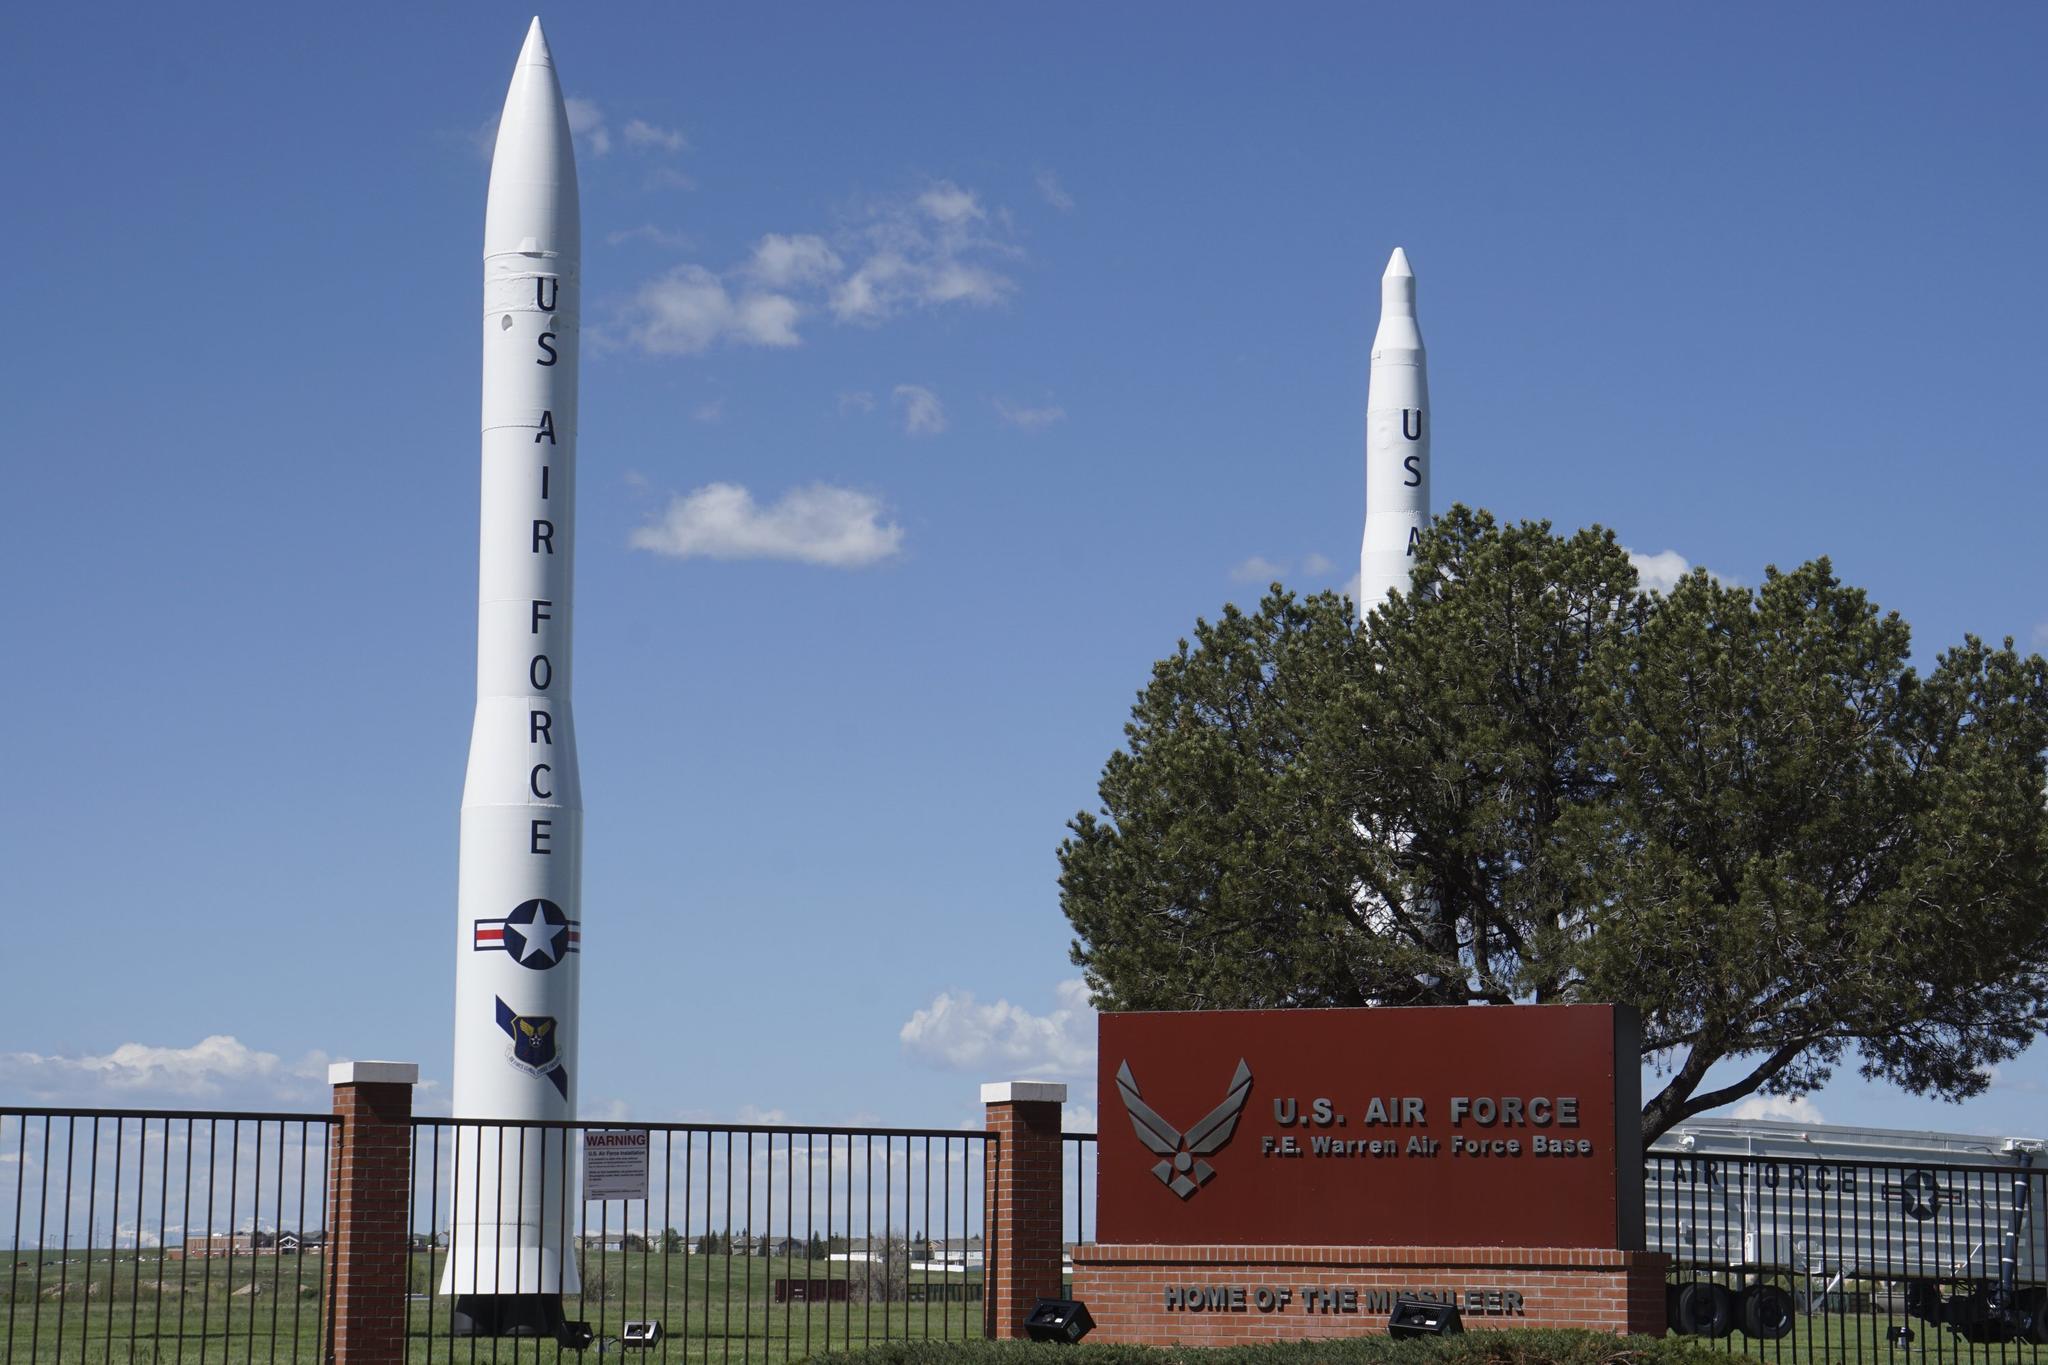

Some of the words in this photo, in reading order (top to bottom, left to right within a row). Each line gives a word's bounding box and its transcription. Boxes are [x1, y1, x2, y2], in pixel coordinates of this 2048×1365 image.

[536, 276, 559, 367] US
[1402, 408, 1422, 487] US
[532, 410, 556, 554] AIR
[529, 599, 553, 854] FORCE
[1273, 1097, 1345, 1124] U.S.
[1364, 1097, 1426, 1124] AIR
[1450, 1096, 1578, 1124] FORCE
[586, 1135, 646, 1146] WARNING
[1261, 1136, 1302, 1154] F.E.
[1310, 1135, 1396, 1154] Warren
[1405, 1135, 1438, 1154] Air
[1451, 1135, 1521, 1154] Force
[1532, 1135, 1592, 1154] Base
[1164, 1284, 1247, 1311] HOME
[1254, 1286, 1291, 1312] OF
[1302, 1286, 1357, 1313] THE
